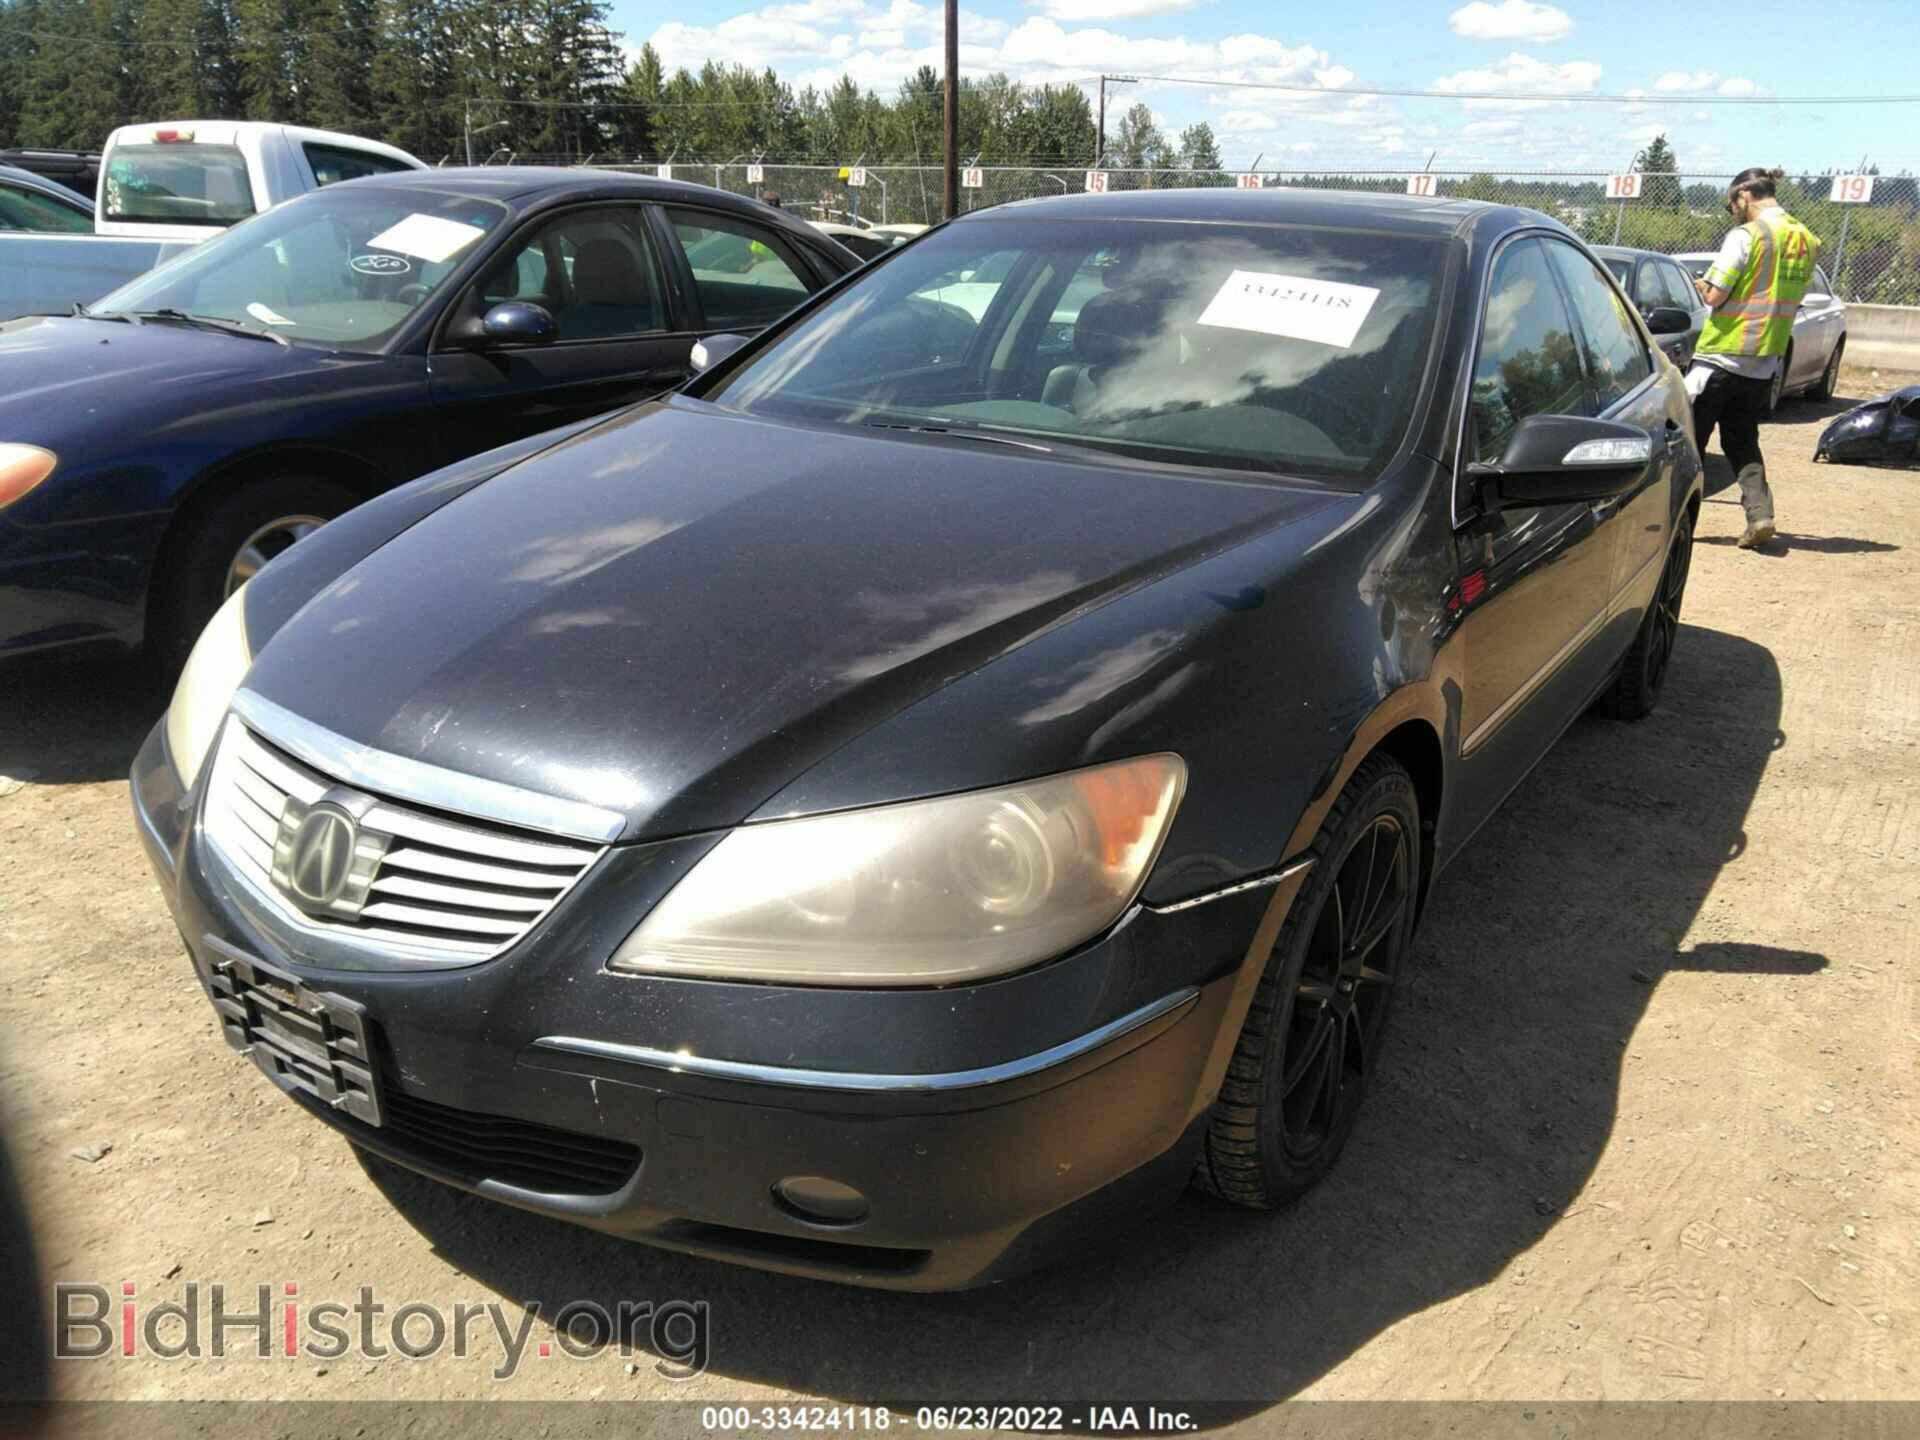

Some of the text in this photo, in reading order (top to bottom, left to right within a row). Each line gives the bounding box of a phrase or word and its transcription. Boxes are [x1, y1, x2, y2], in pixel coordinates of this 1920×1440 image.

[851, 168, 864, 185] 13
[966, 168, 979, 185] 14
[1090, 172, 1104, 191] 15
[1243, 174, 1259, 188] 16
[1415, 175, 1432, 195] 17
[1613, 175, 1636, 196] 18
[1840, 177, 1866, 200] 19
